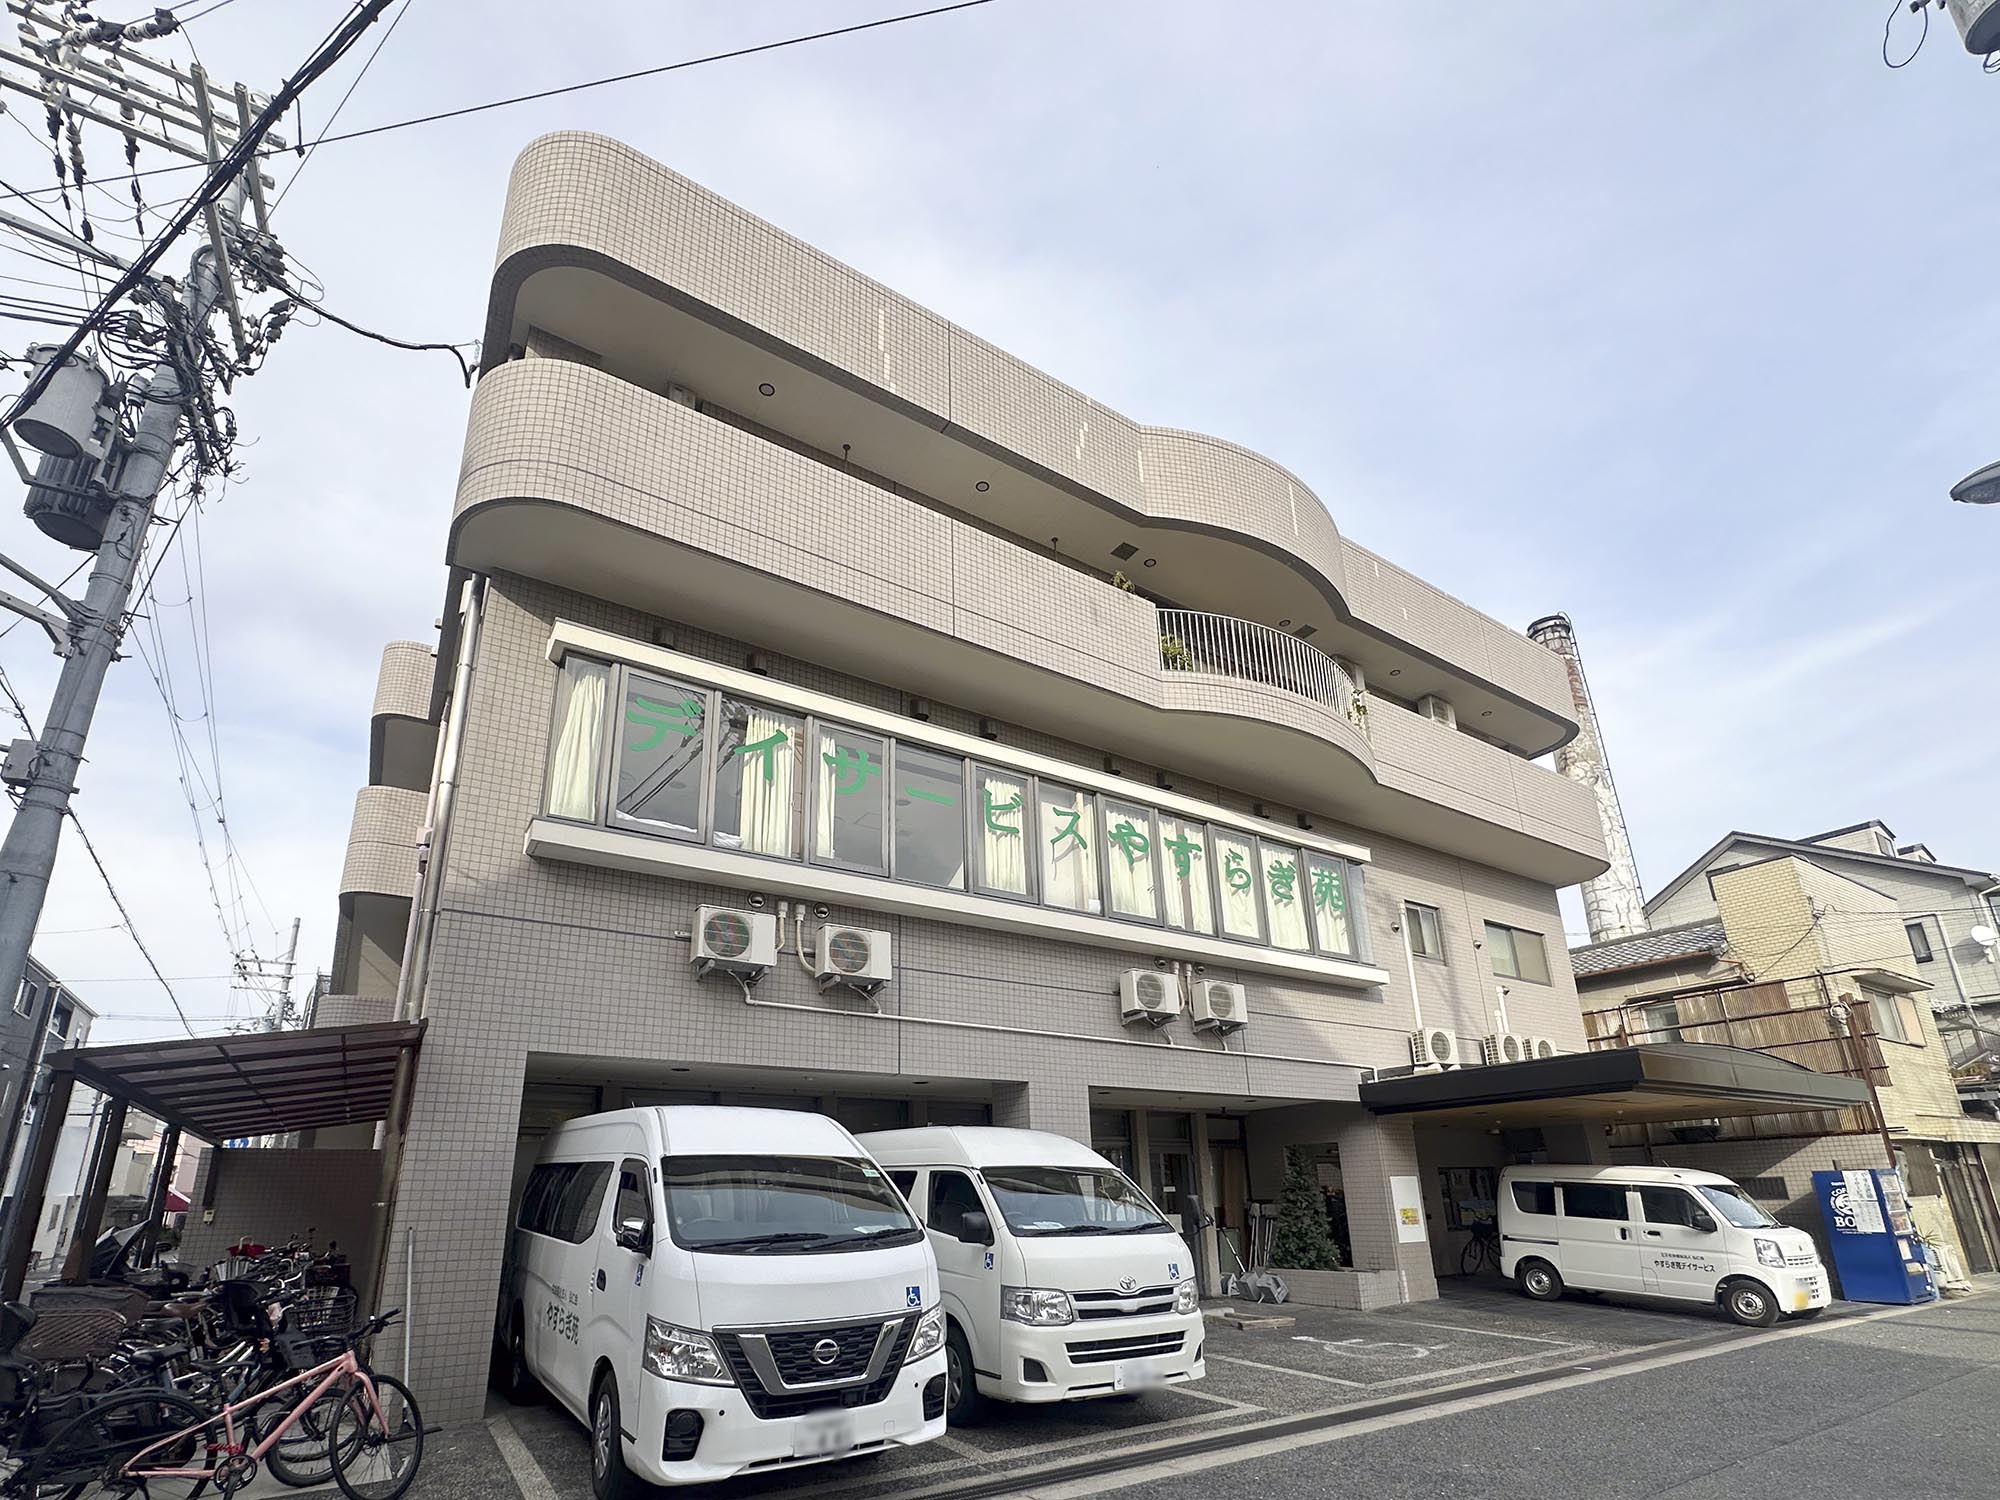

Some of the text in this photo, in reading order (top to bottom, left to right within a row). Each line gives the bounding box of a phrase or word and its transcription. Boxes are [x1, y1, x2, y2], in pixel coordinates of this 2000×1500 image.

[626, 694, 1346, 912] デイサービスやすらぎ苑
[1831, 1188, 1847, 1197] COF
[1833, 1216, 1856, 1228] BO
